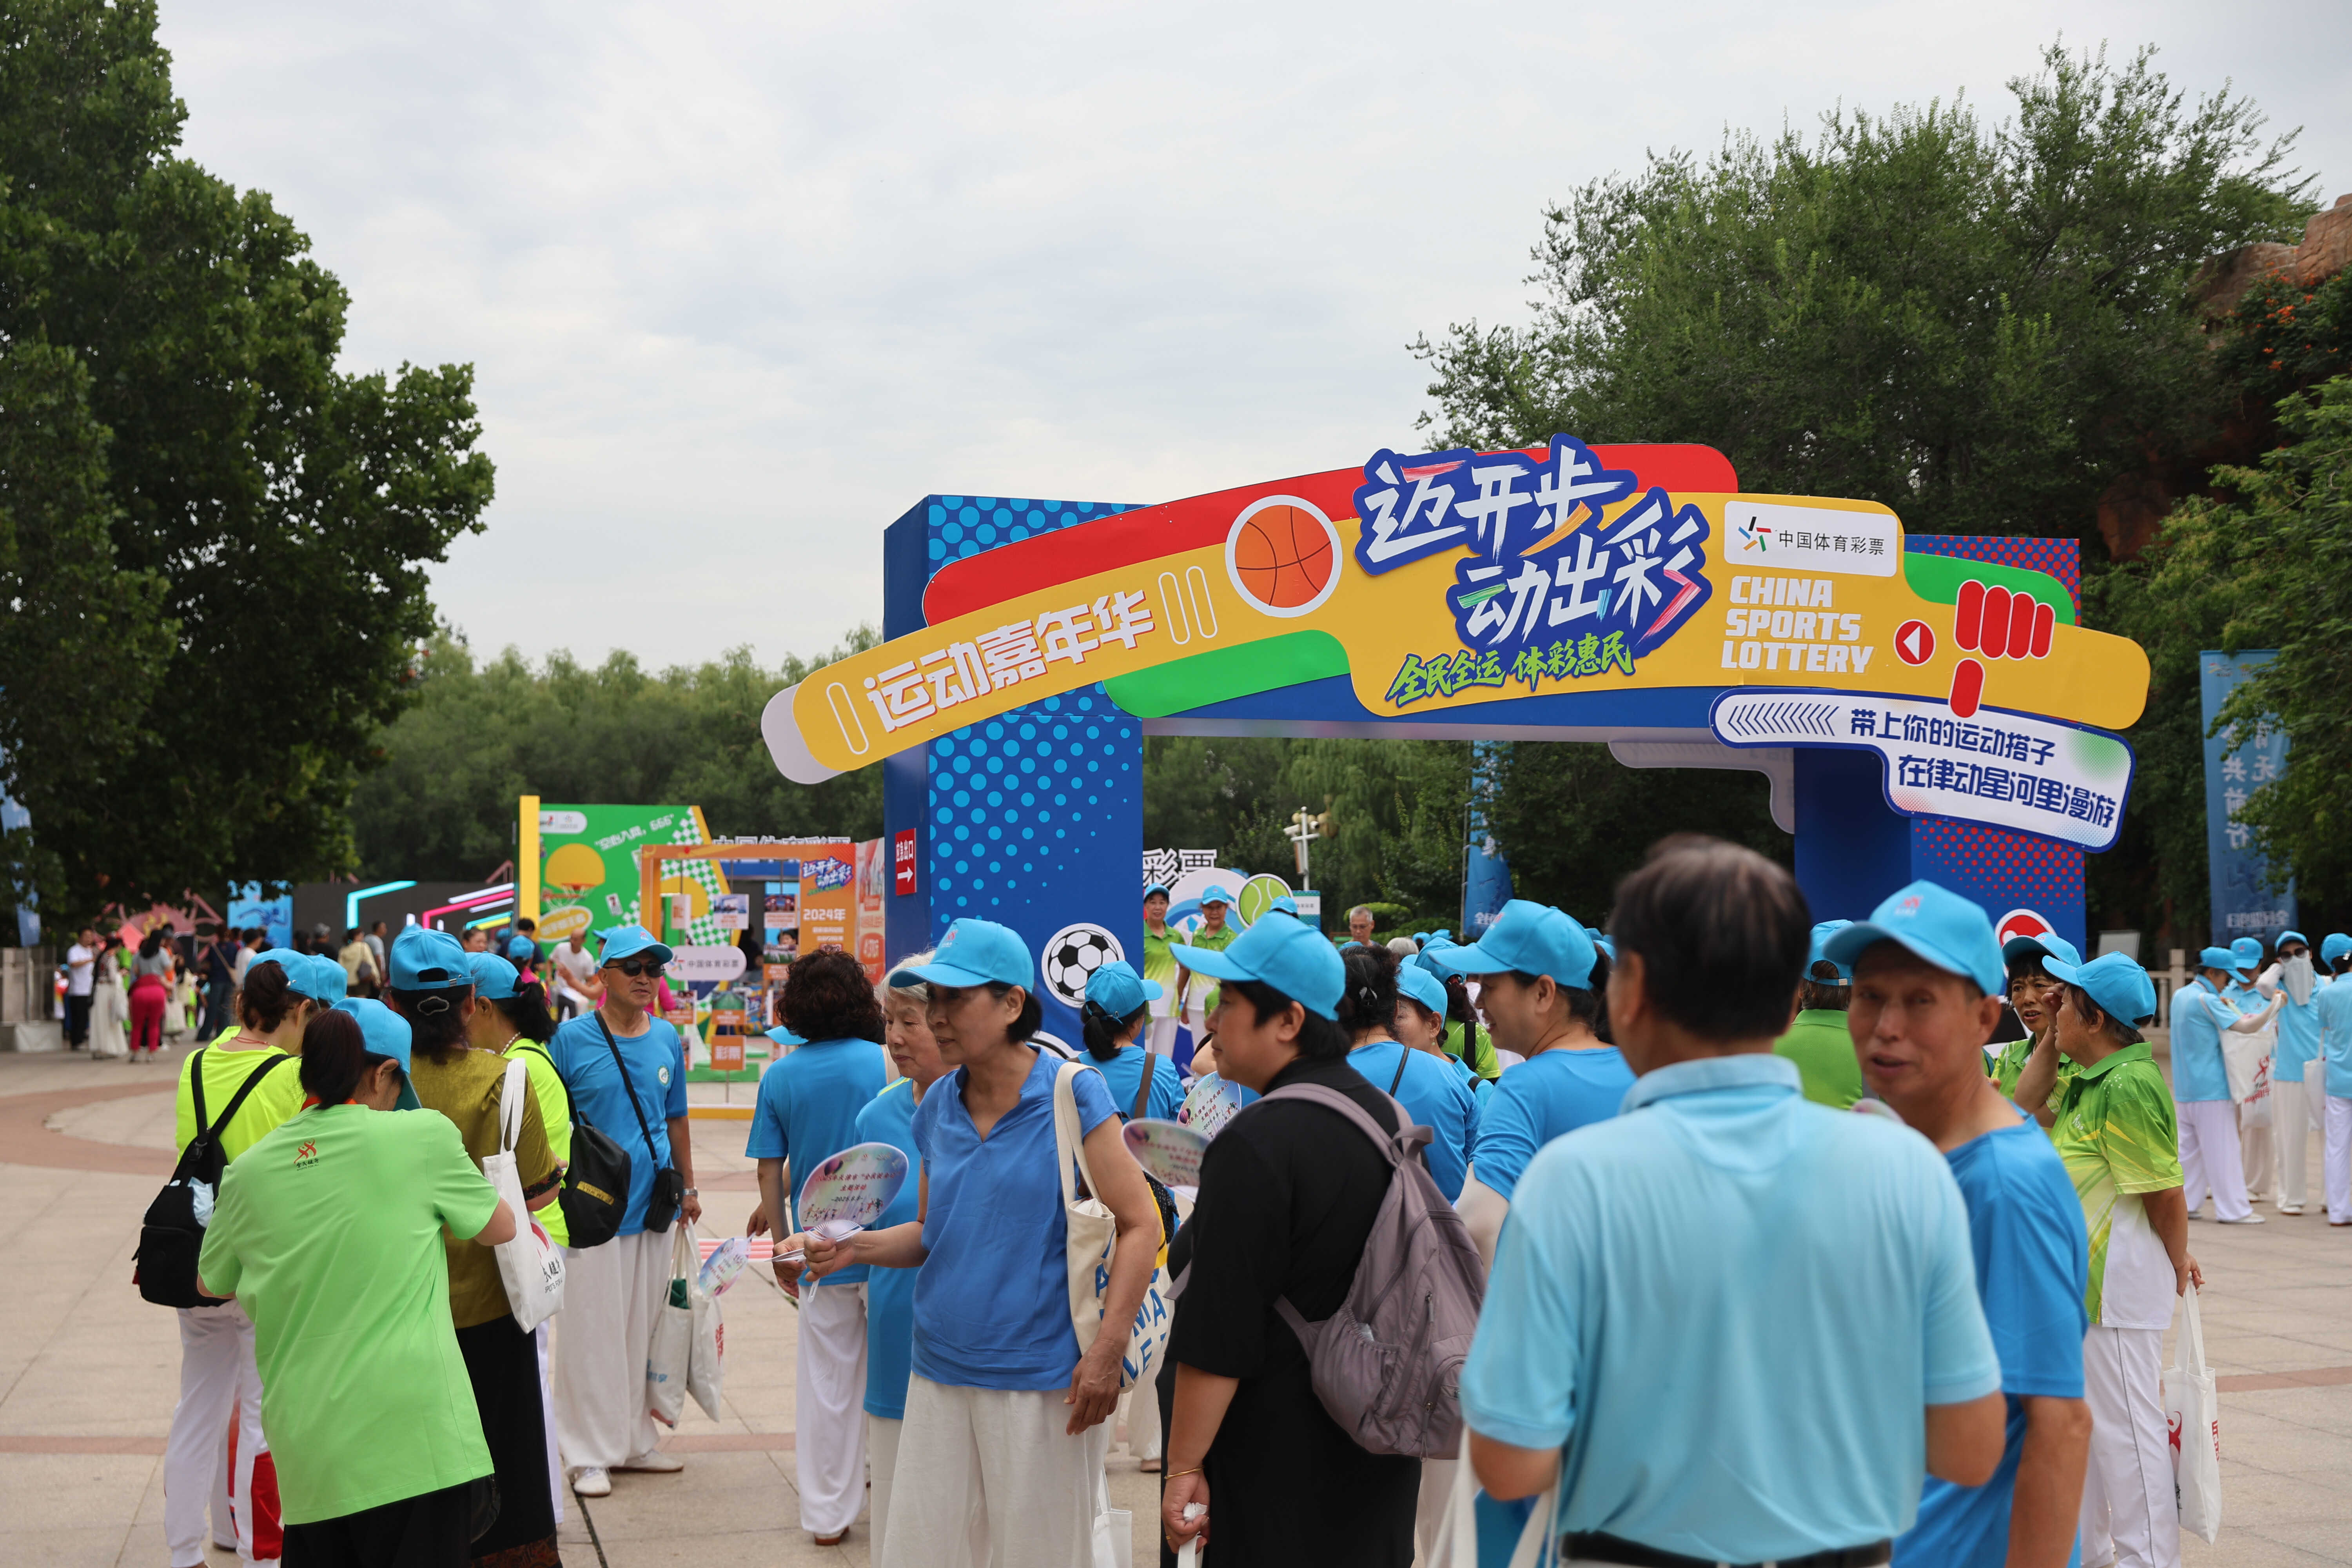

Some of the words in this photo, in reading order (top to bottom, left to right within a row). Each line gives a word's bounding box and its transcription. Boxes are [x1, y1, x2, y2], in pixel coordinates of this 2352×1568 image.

[1365, 445, 1626, 564] 迈开步
[1779, 530, 1884, 555] 中国体育彩票
[1457, 499, 1702, 647] 动出彩
[1730, 576, 1833, 608] CHINA
[1726, 608, 1861, 641] SPORTS
[864, 590, 1155, 733] 运动嘉年华
[1387, 650, 1506, 705] 全民全运
[1510, 630, 1634, 689] 体彩惠民
[1721, 640, 1874, 673] LOTTERY
[1851, 709, 2056, 766] 带上你的运动搭子
[1898, 754, 2117, 828] 在律动星河里漫游
[896, 839, 913, 862] 应急出口
[803, 909, 846, 921] 2024年
[688, 960, 739, 968] 中国体育彩票
[715, 1046, 742, 1060] 彩票
[1201, 1104, 1216, 1122] 主题活动
